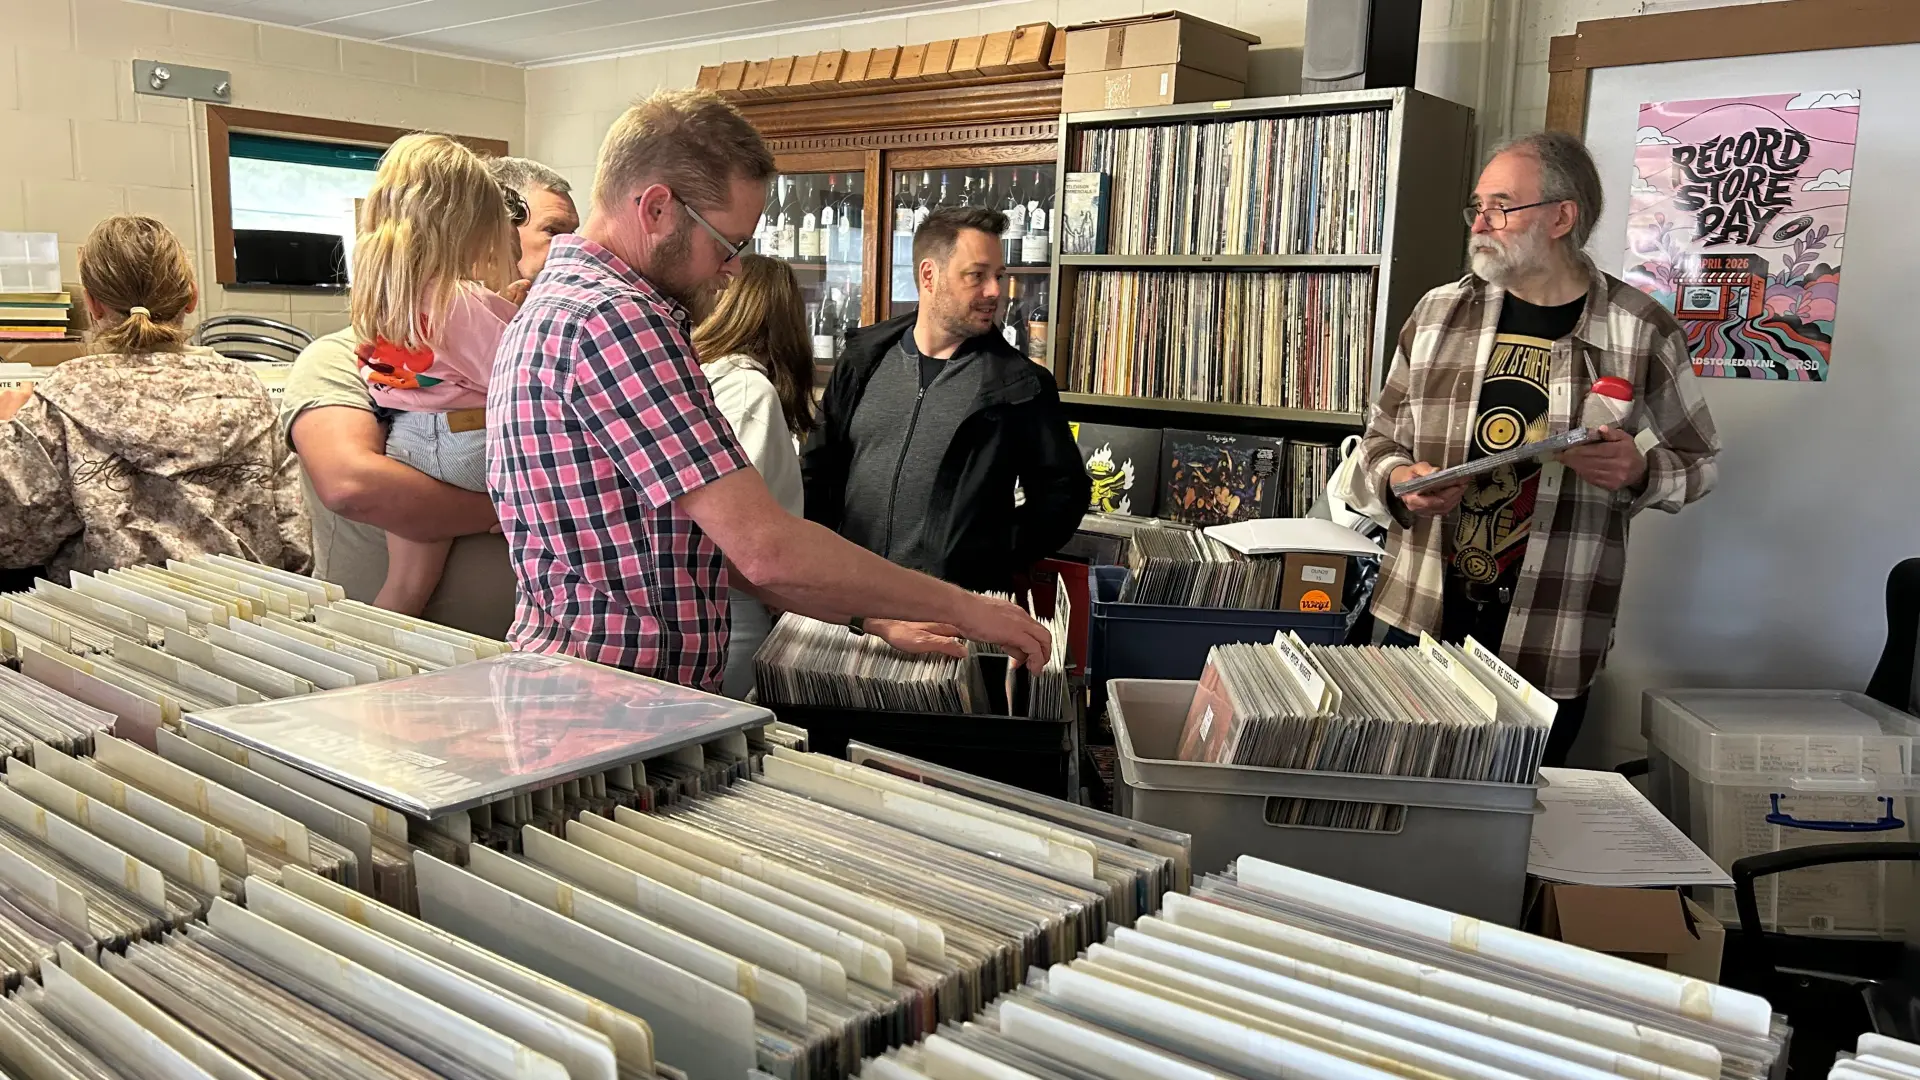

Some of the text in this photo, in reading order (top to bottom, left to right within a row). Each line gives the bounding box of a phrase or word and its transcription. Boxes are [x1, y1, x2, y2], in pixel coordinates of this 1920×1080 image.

[1672, 127, 1811, 184] RECORD
[1673, 166, 1799, 211] STORE
[1692, 199, 1784, 247] DAY
[1725, 258, 1749, 269] 2026
[1506, 345, 1524, 375] IS
[1518, 346, 1550, 389] FOREVE
[1795, 359, 1820, 371] RSD
[1474, 647, 1497, 672] KRAUTROCK
